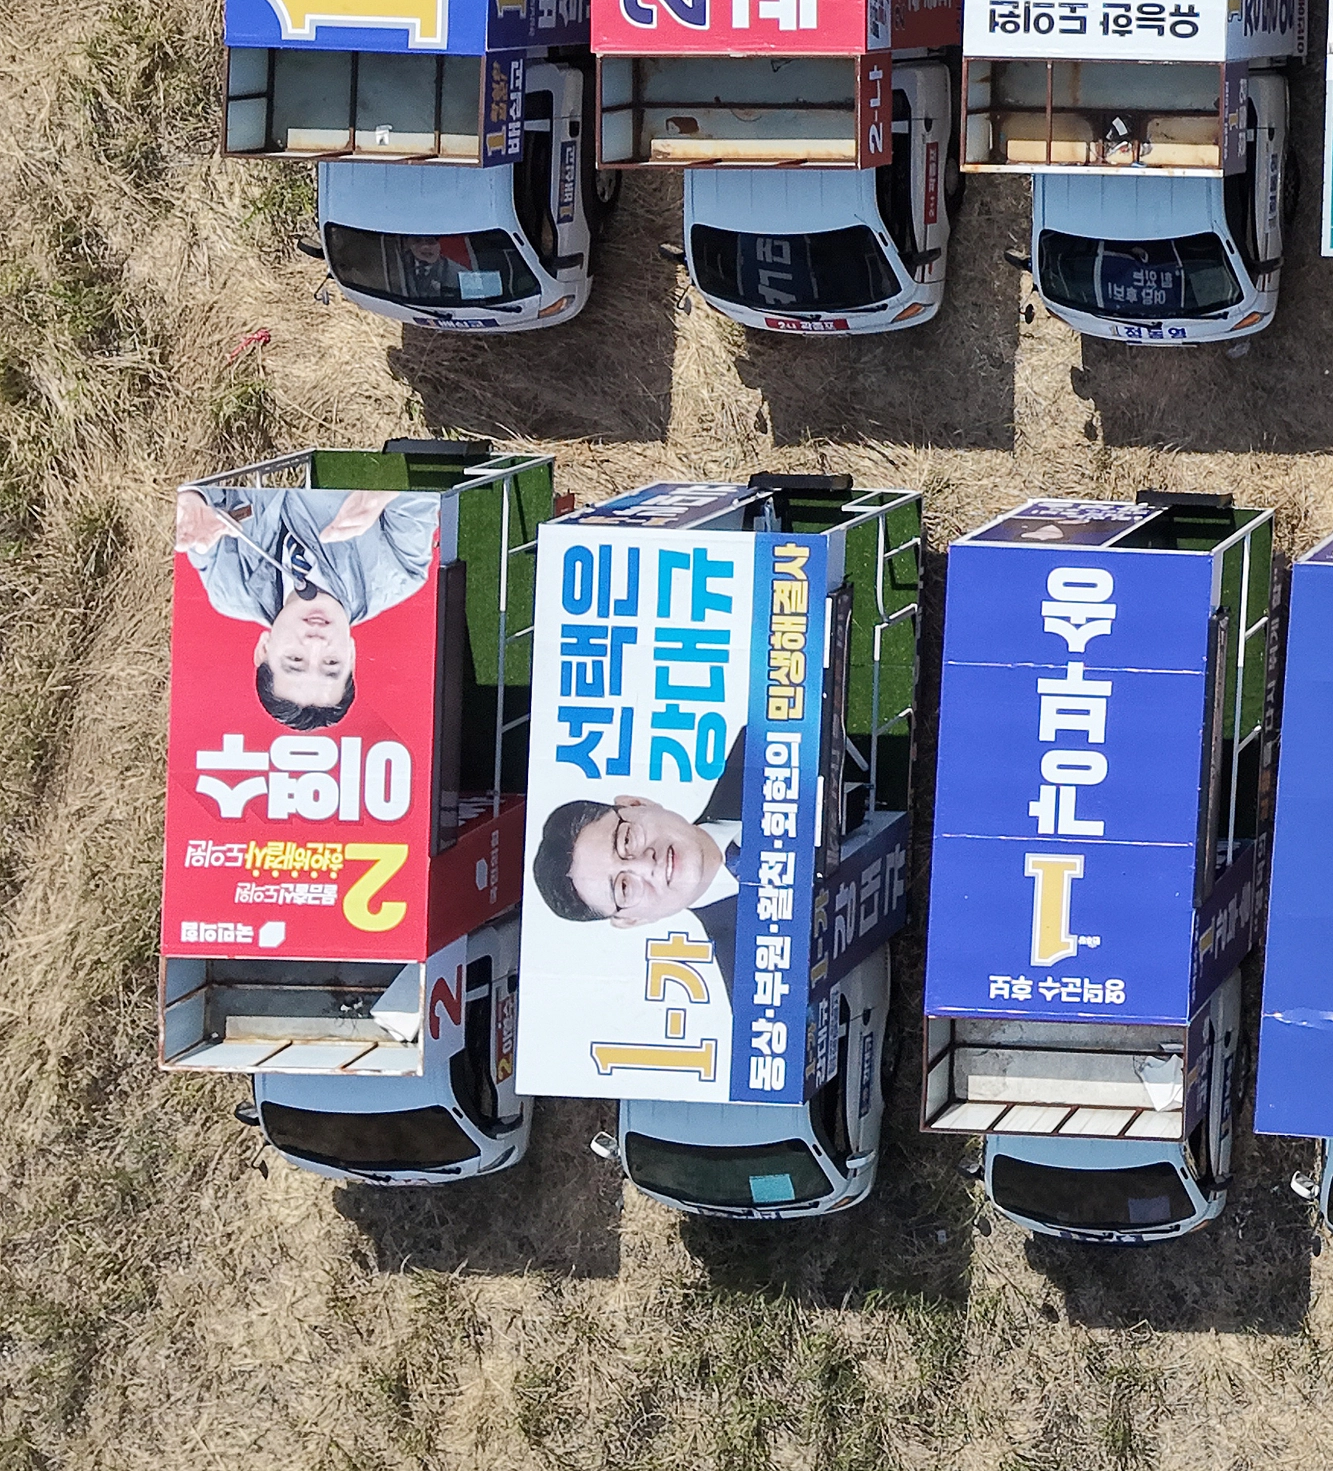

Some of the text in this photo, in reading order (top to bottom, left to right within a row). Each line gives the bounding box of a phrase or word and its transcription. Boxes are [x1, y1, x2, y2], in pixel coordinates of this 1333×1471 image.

[989, 0, 1199, 38] 유능한 도의원
[508, 59, 522, 154] 배심교
[869, 64, 883, 154] 2-나
[555, 543, 640, 779] 선택은
[649, 547, 734, 781] 강대규
[1028, 564, 1116, 837] 강부송
[196, 733, 412, 821] 이영수
[181, 922, 255, 943] 국민의힘
[1023, 852, 1084, 967] 1
[590, 932, 717, 1083] 1-가
[988, 974, 1126, 1003] 영덕군수 후보
